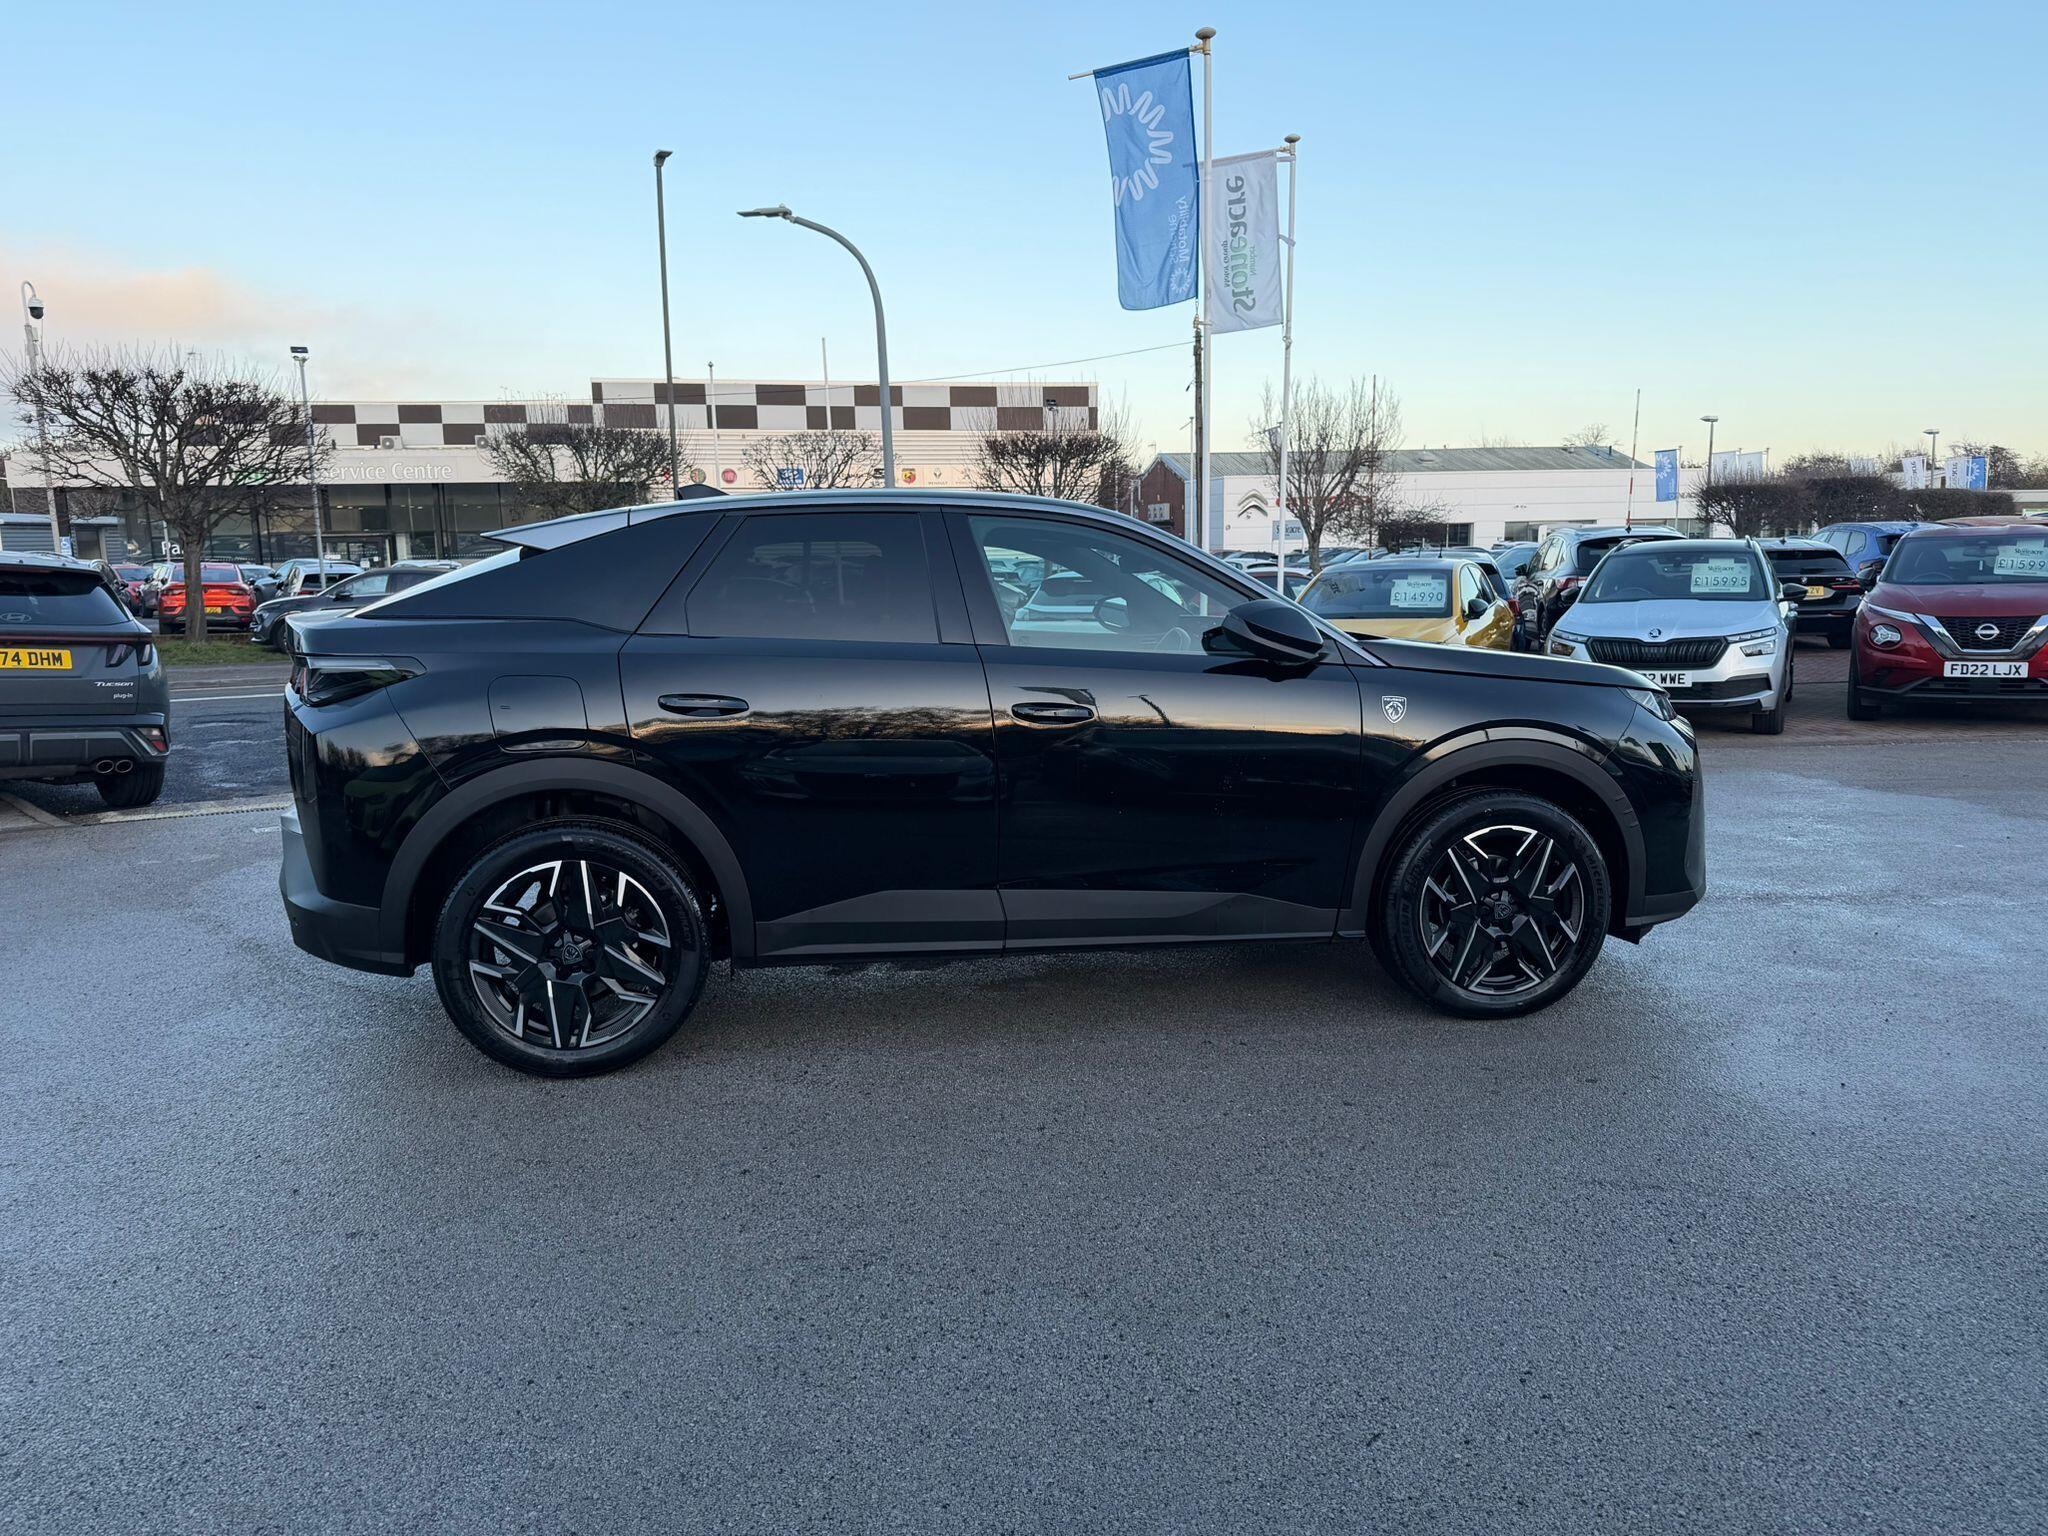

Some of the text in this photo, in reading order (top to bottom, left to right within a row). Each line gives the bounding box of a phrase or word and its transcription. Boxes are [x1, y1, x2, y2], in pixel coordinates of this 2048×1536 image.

[391, 462, 452, 480] Centre
[1694, 576, 1748, 586] £15995
[1394, 592, 1443, 601] £14990
[27, 652, 63, 666] DHM
[1951, 664, 2022, 676] FD22 LJX
[1660, 673, 1686, 684] WWE
[1586, 855, 1605, 917] MICHELIN
